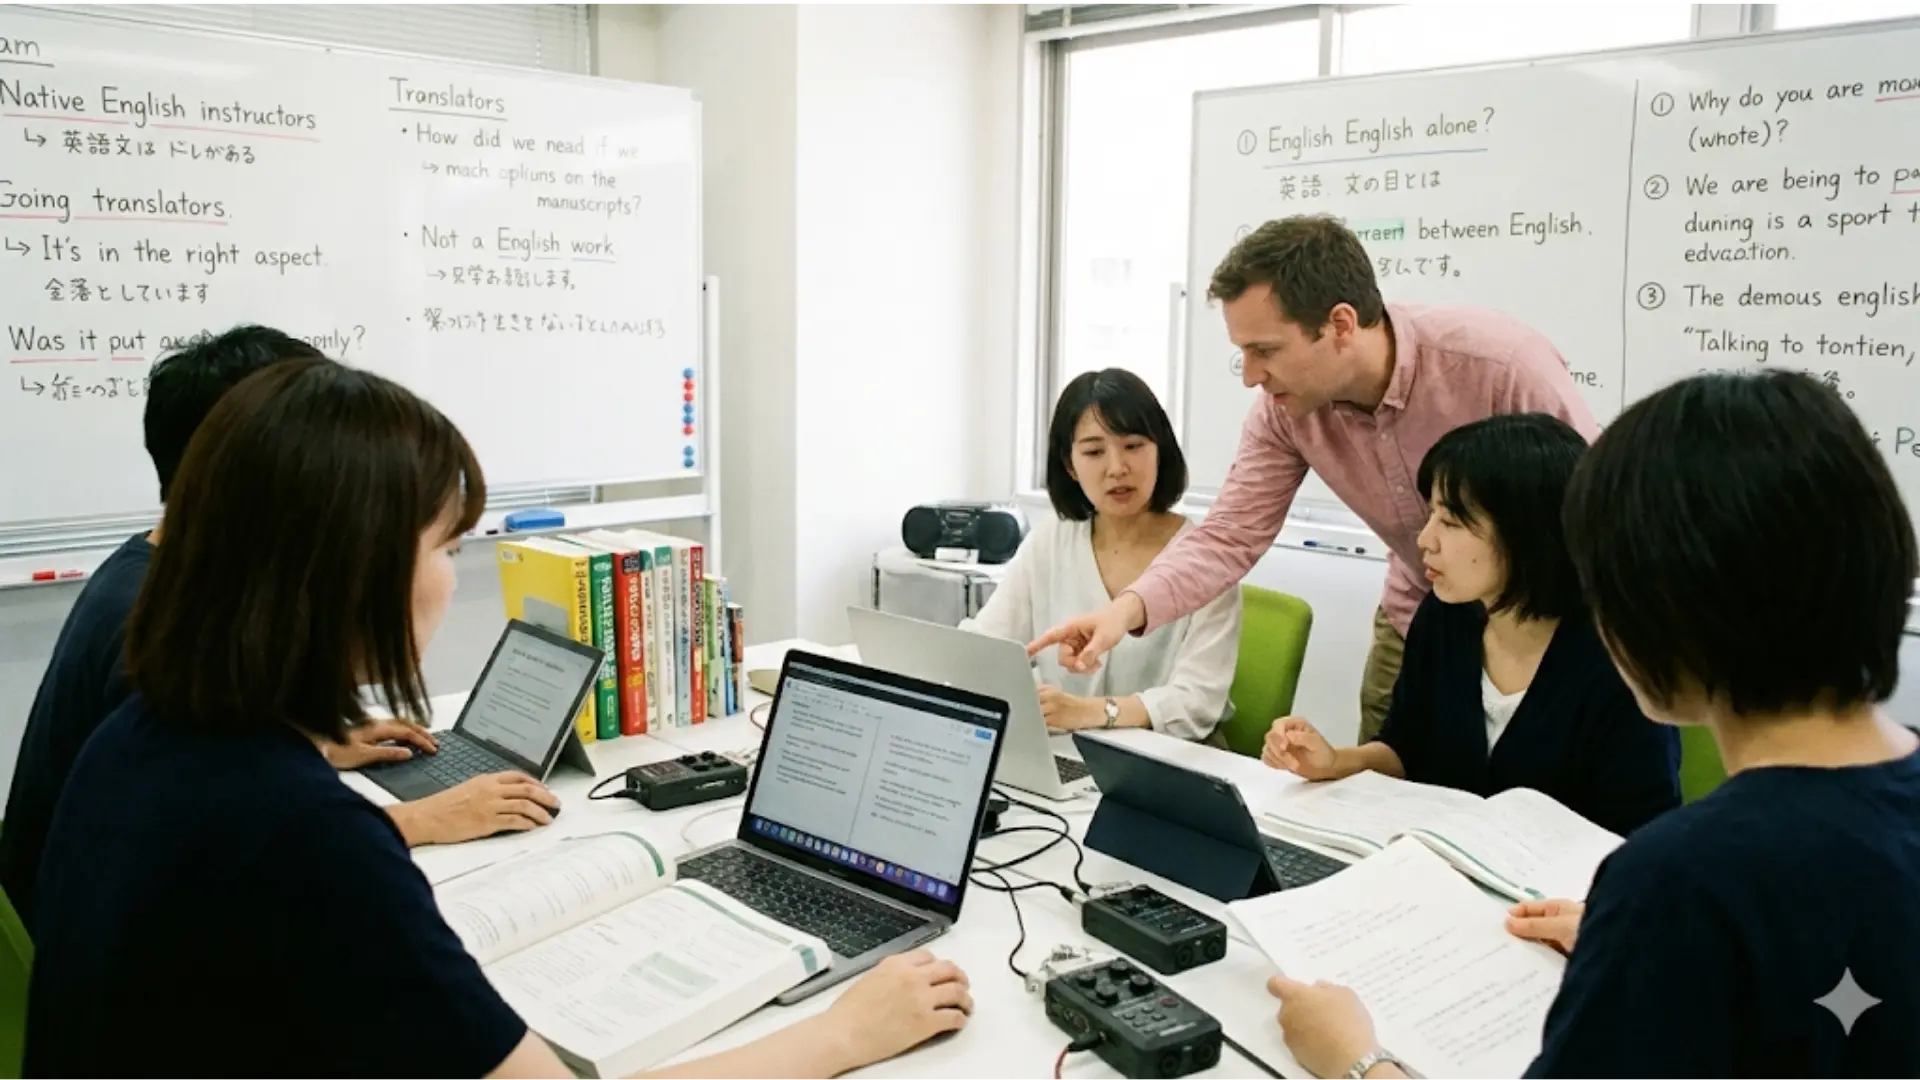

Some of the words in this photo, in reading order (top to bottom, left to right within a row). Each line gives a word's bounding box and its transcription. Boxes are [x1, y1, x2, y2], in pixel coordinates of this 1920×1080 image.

[0, 78, 86, 112] Native
[101, 86, 186, 128] English
[201, 100, 317, 130] instructors
[389, 76, 505, 113] Translators
[1689, 91, 1731, 116] Why
[1739, 84, 1764, 108] do
[1776, 86, 1814, 113] you
[1827, 81, 1864, 99] are
[416, 122, 458, 146] How
[473, 128, 501, 148] did
[513, 137, 536, 151] we
[1269, 126, 1333, 161] English
[1346, 117, 1414, 152] English
[1427, 106, 1495, 137] alone?
[446, 160, 490, 179] mach
[565, 171, 584, 185] on
[592, 170, 616, 189] the
[1686, 173, 1719, 197] We
[1732, 176, 1769, 194] are
[1783, 167, 1841, 201] being
[1854, 164, 1880, 186] to
[0, 179, 71, 224] Going
[537, 195, 642, 219] manuscripts?
[1767, 212, 1785, 230] is
[1797, 214, 1813, 229] a
[1827, 202, 1892, 236] sport
[422, 225, 459, 249] Not
[472, 236, 484, 249] a
[498, 227, 561, 261] English
[571, 234, 614, 254] work
[1419, 218, 1499, 241] between
[1510, 211, 1592, 245] English.
[42, 235, 81, 262] It's
[99, 240, 120, 263] in
[134, 239, 173, 264] the
[186, 242, 240, 275] right
[1683, 283, 1724, 307] The
[1739, 284, 1822, 307] demous
[1837, 281, 1920, 318] english
[9, 325, 65, 351] Was
[80, 329, 98, 351] it
[109, 329, 146, 355] put
[1780, 333, 1804, 353] to
[1816, 334, 1915, 367] tontien,
